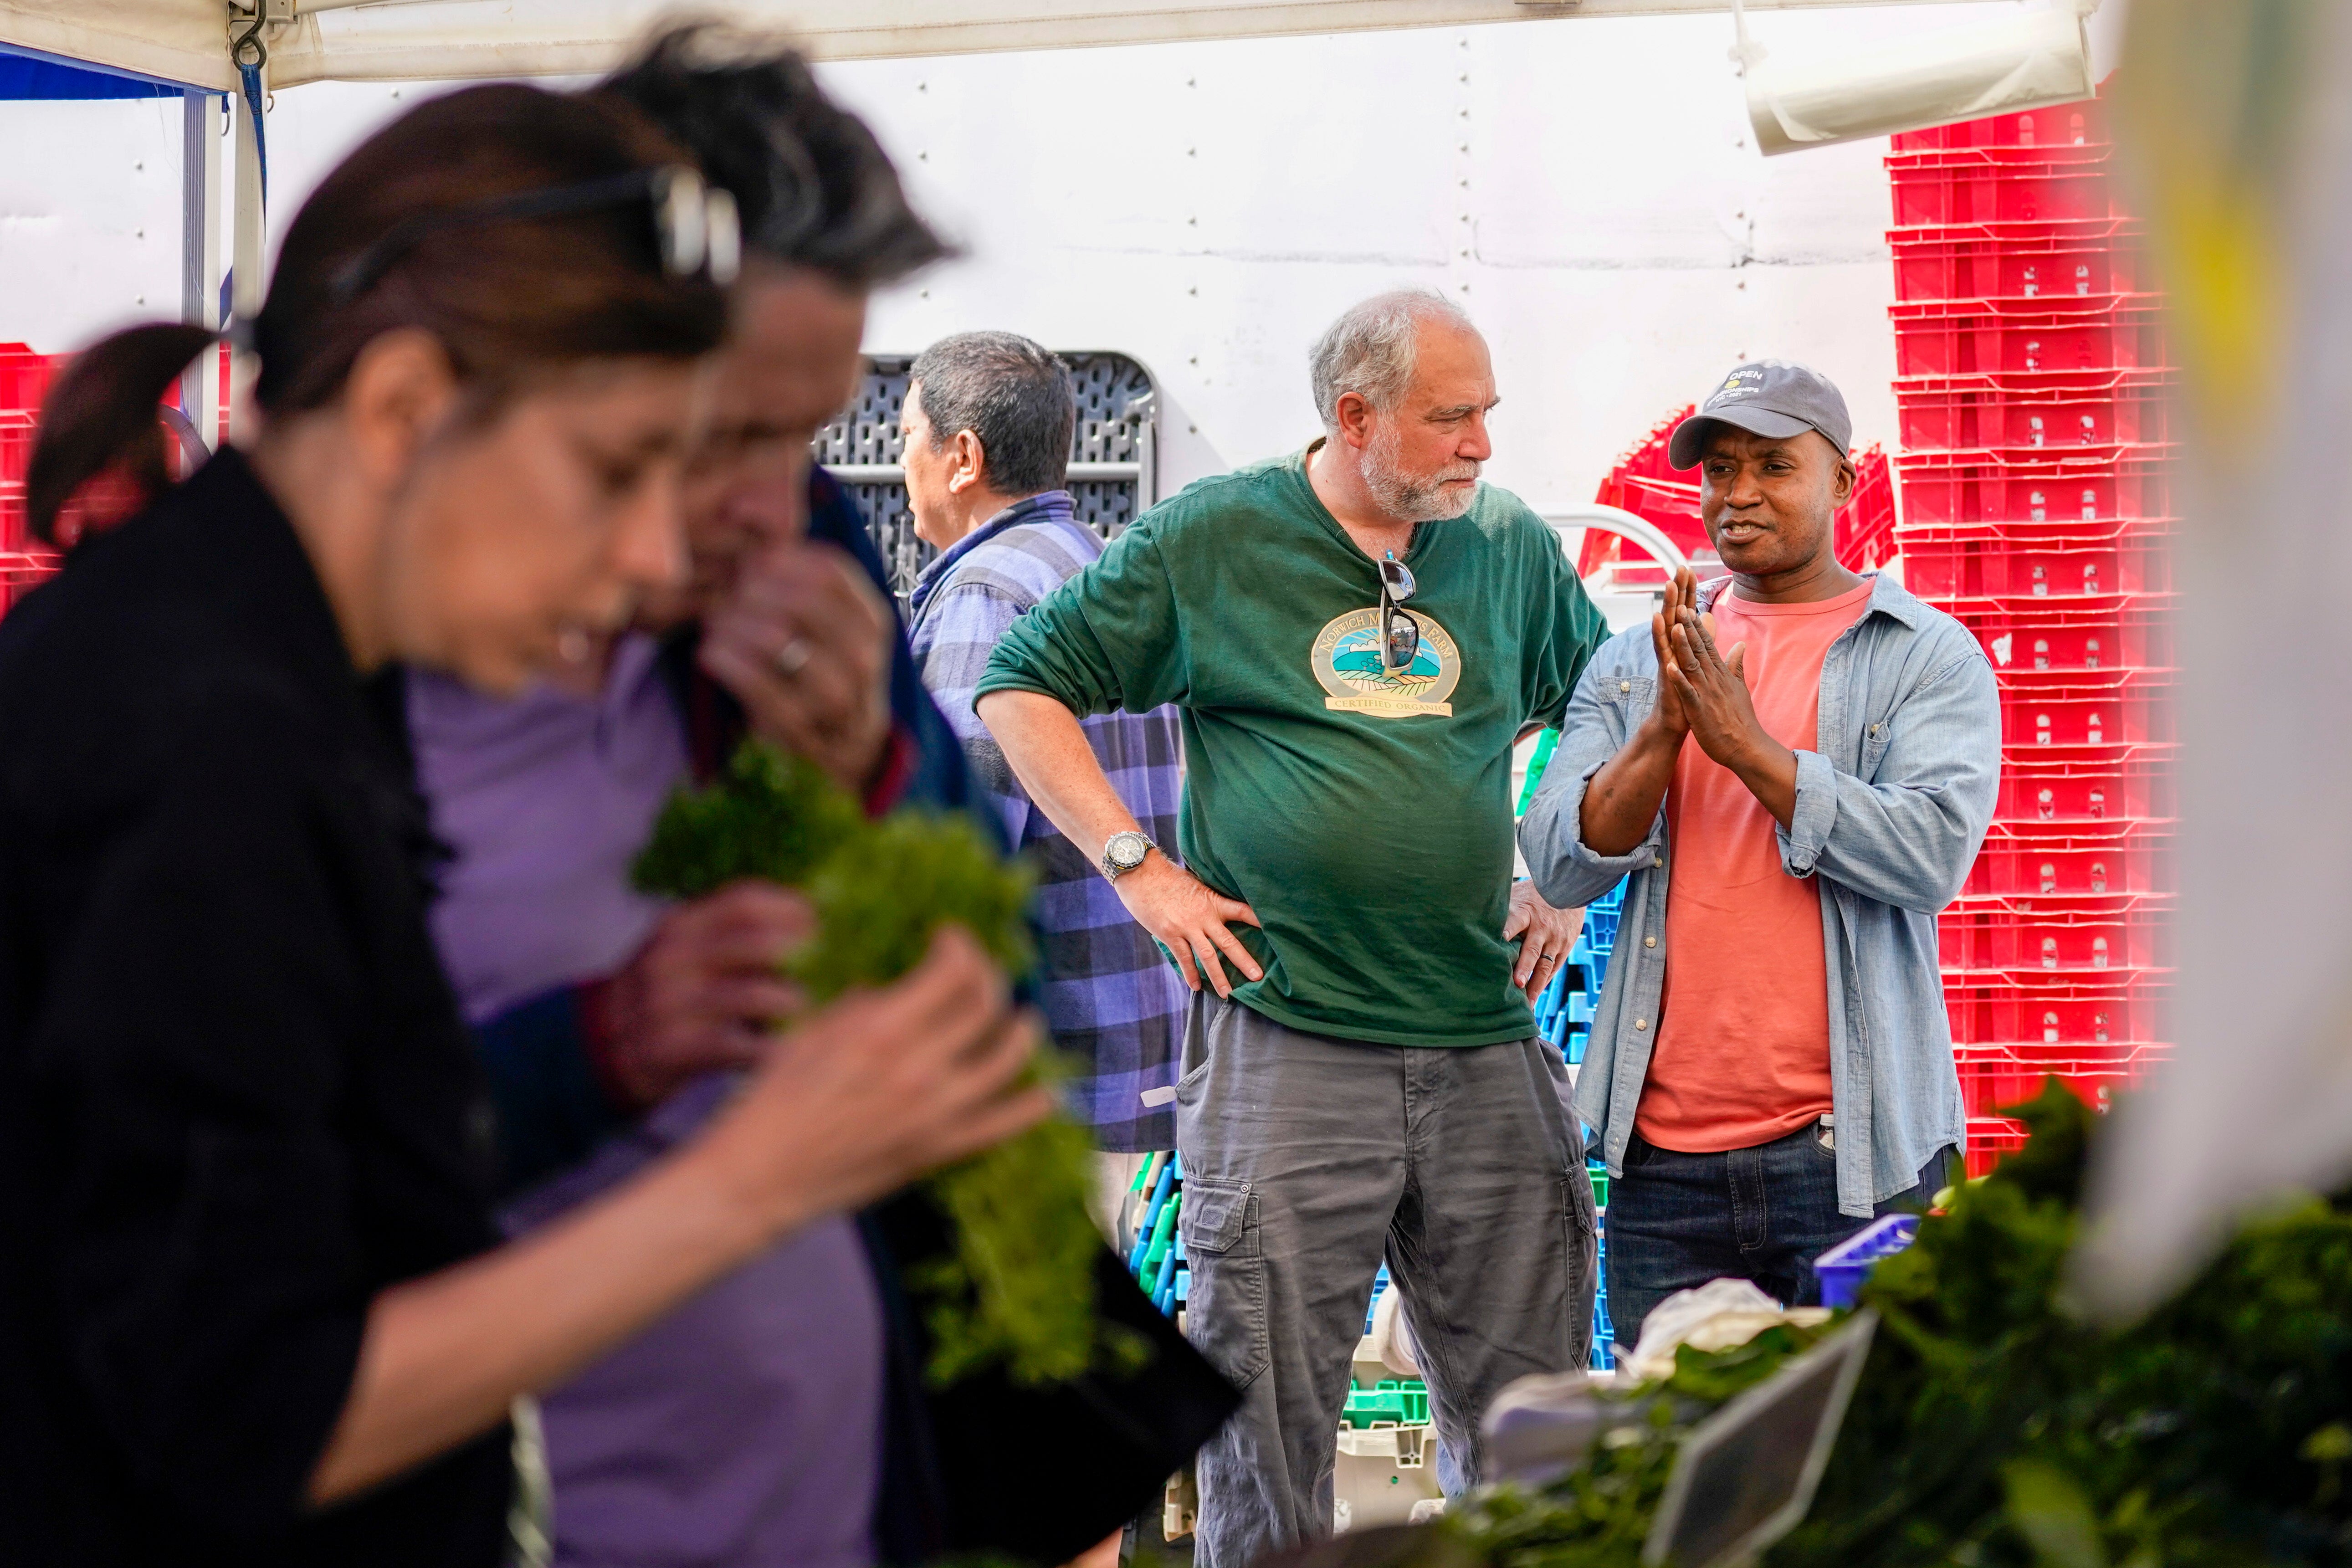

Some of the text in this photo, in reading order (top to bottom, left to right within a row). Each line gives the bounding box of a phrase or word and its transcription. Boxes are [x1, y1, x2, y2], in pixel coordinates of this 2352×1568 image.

[1730, 370, 1763, 380] OPEN
[1716, 395, 1726, 403] NYC
[1318, 615, 1365, 653] NORWICH
[1426, 626, 1454, 658] FARM
[1335, 699, 1445, 712] CERTIFIED ORGANIC
